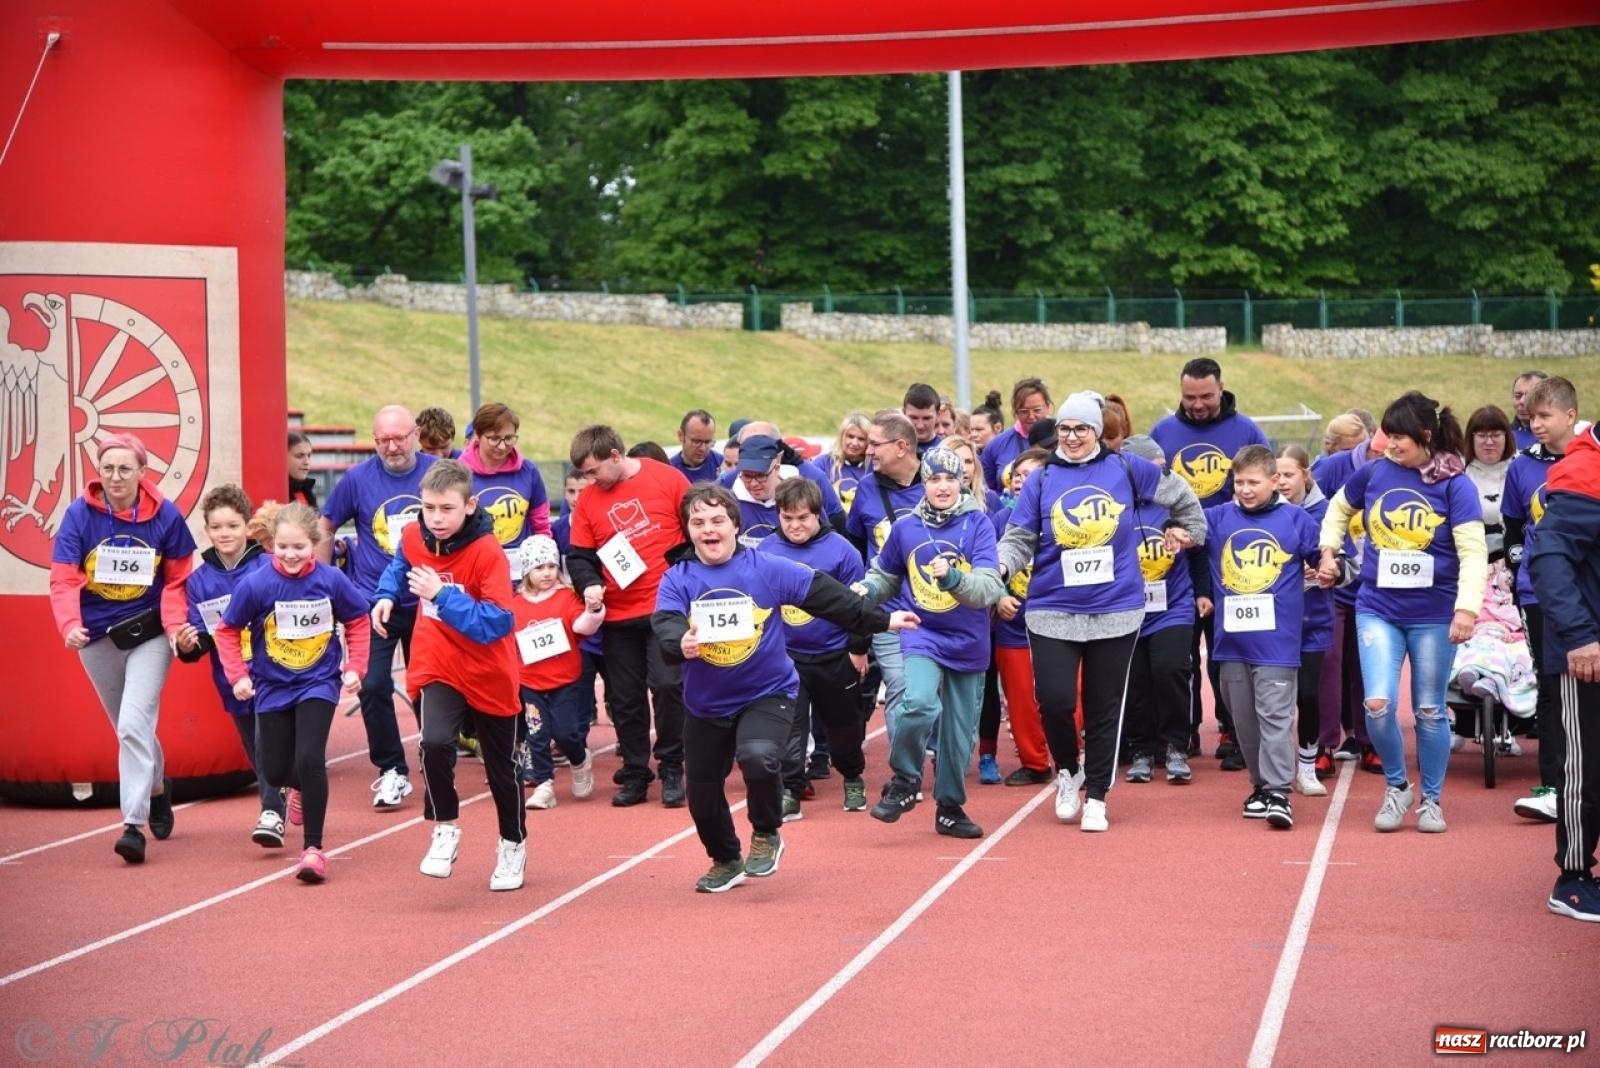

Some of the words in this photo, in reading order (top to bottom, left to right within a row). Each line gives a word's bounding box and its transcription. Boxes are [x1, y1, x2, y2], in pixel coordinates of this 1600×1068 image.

[112, 559, 139, 572] 156
[613, 549, 631, 571] 128
[1074, 559, 1102, 573] 077
[1390, 563, 1421, 575] 089
[292, 612, 320, 627] 166
[708, 613, 739, 628] 154
[1235, 607, 1260, 620] 081
[531, 633, 556, 649] 132
